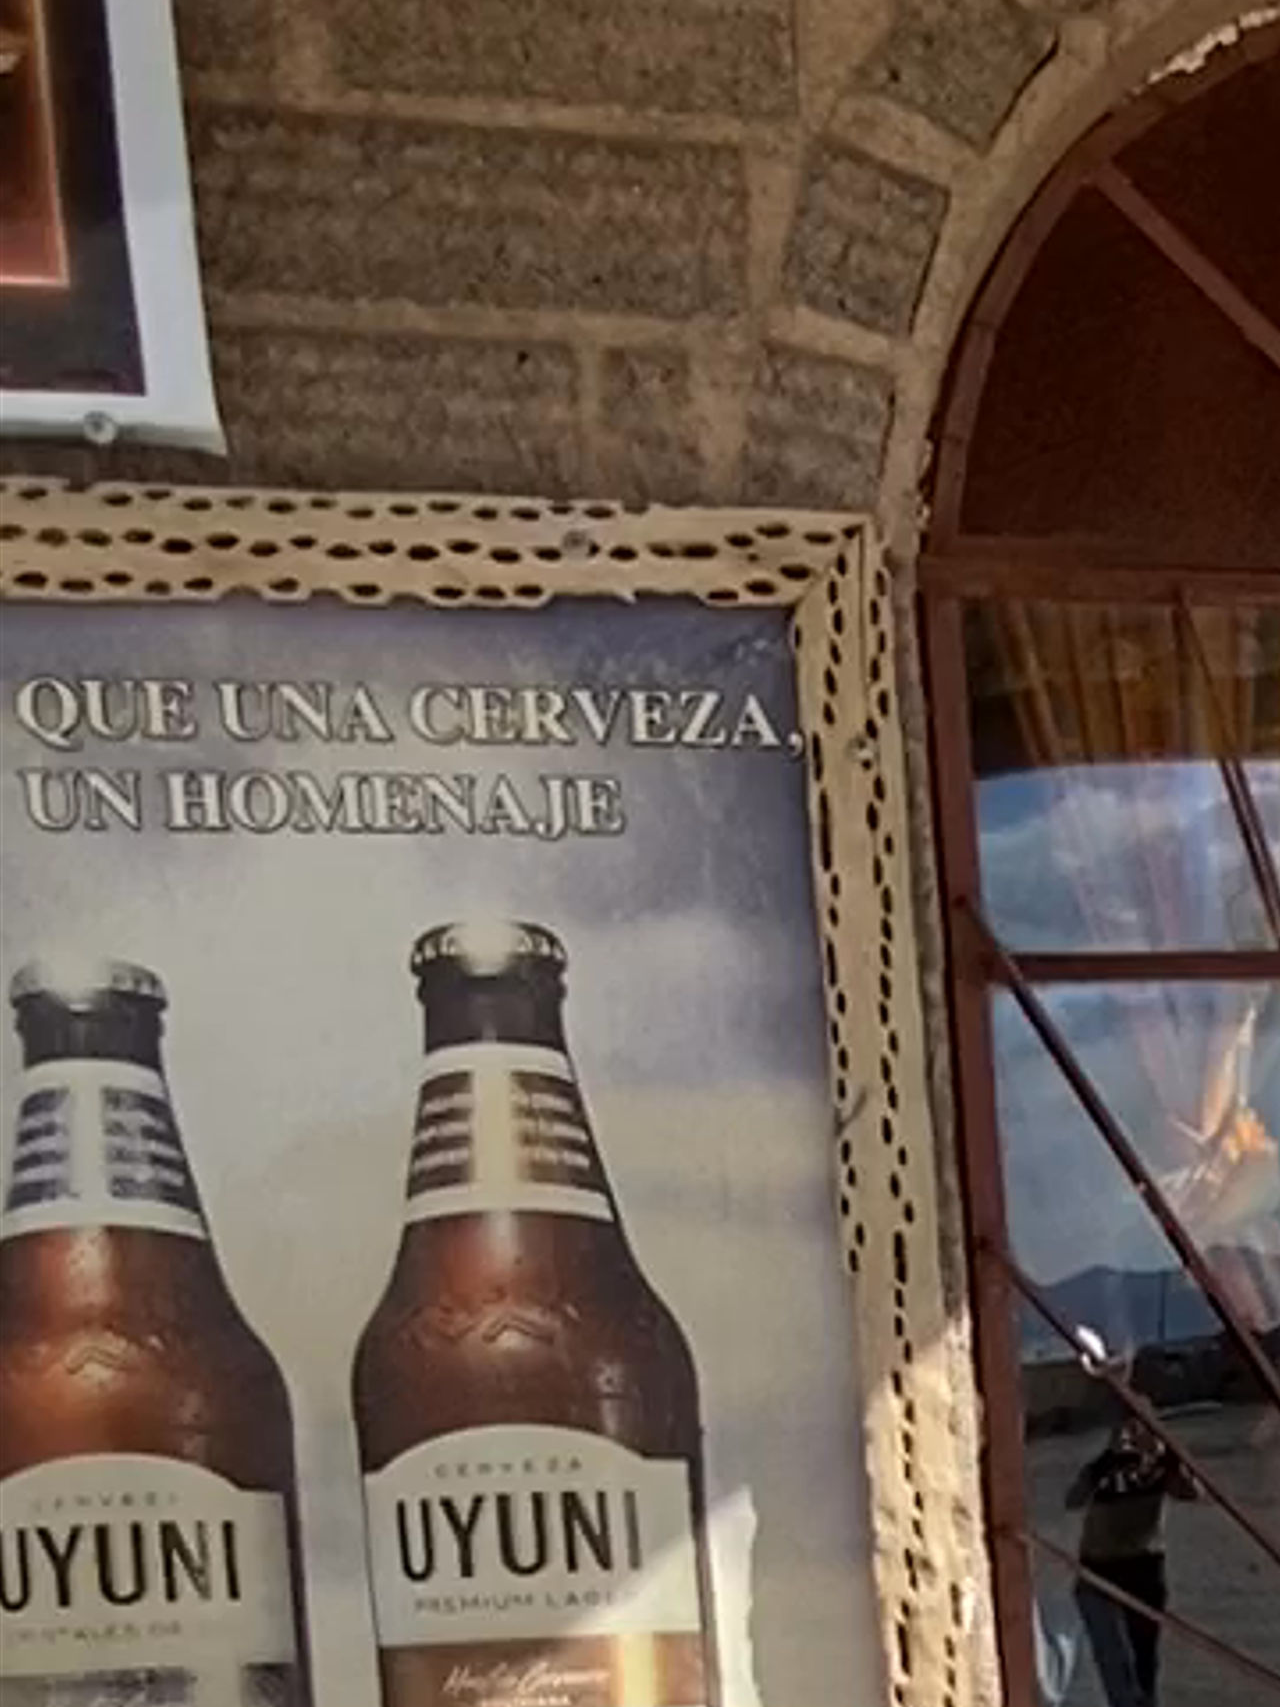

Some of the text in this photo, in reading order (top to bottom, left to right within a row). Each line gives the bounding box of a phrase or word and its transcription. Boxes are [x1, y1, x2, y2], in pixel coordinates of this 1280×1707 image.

[15, 676, 805, 757] QUE UNA CERVEZA,
[20, 767, 625, 840] UN HOMENAJE
[0, 1519, 242, 1613] UYUNI
[395, 1490, 644, 1582] UYUNI
